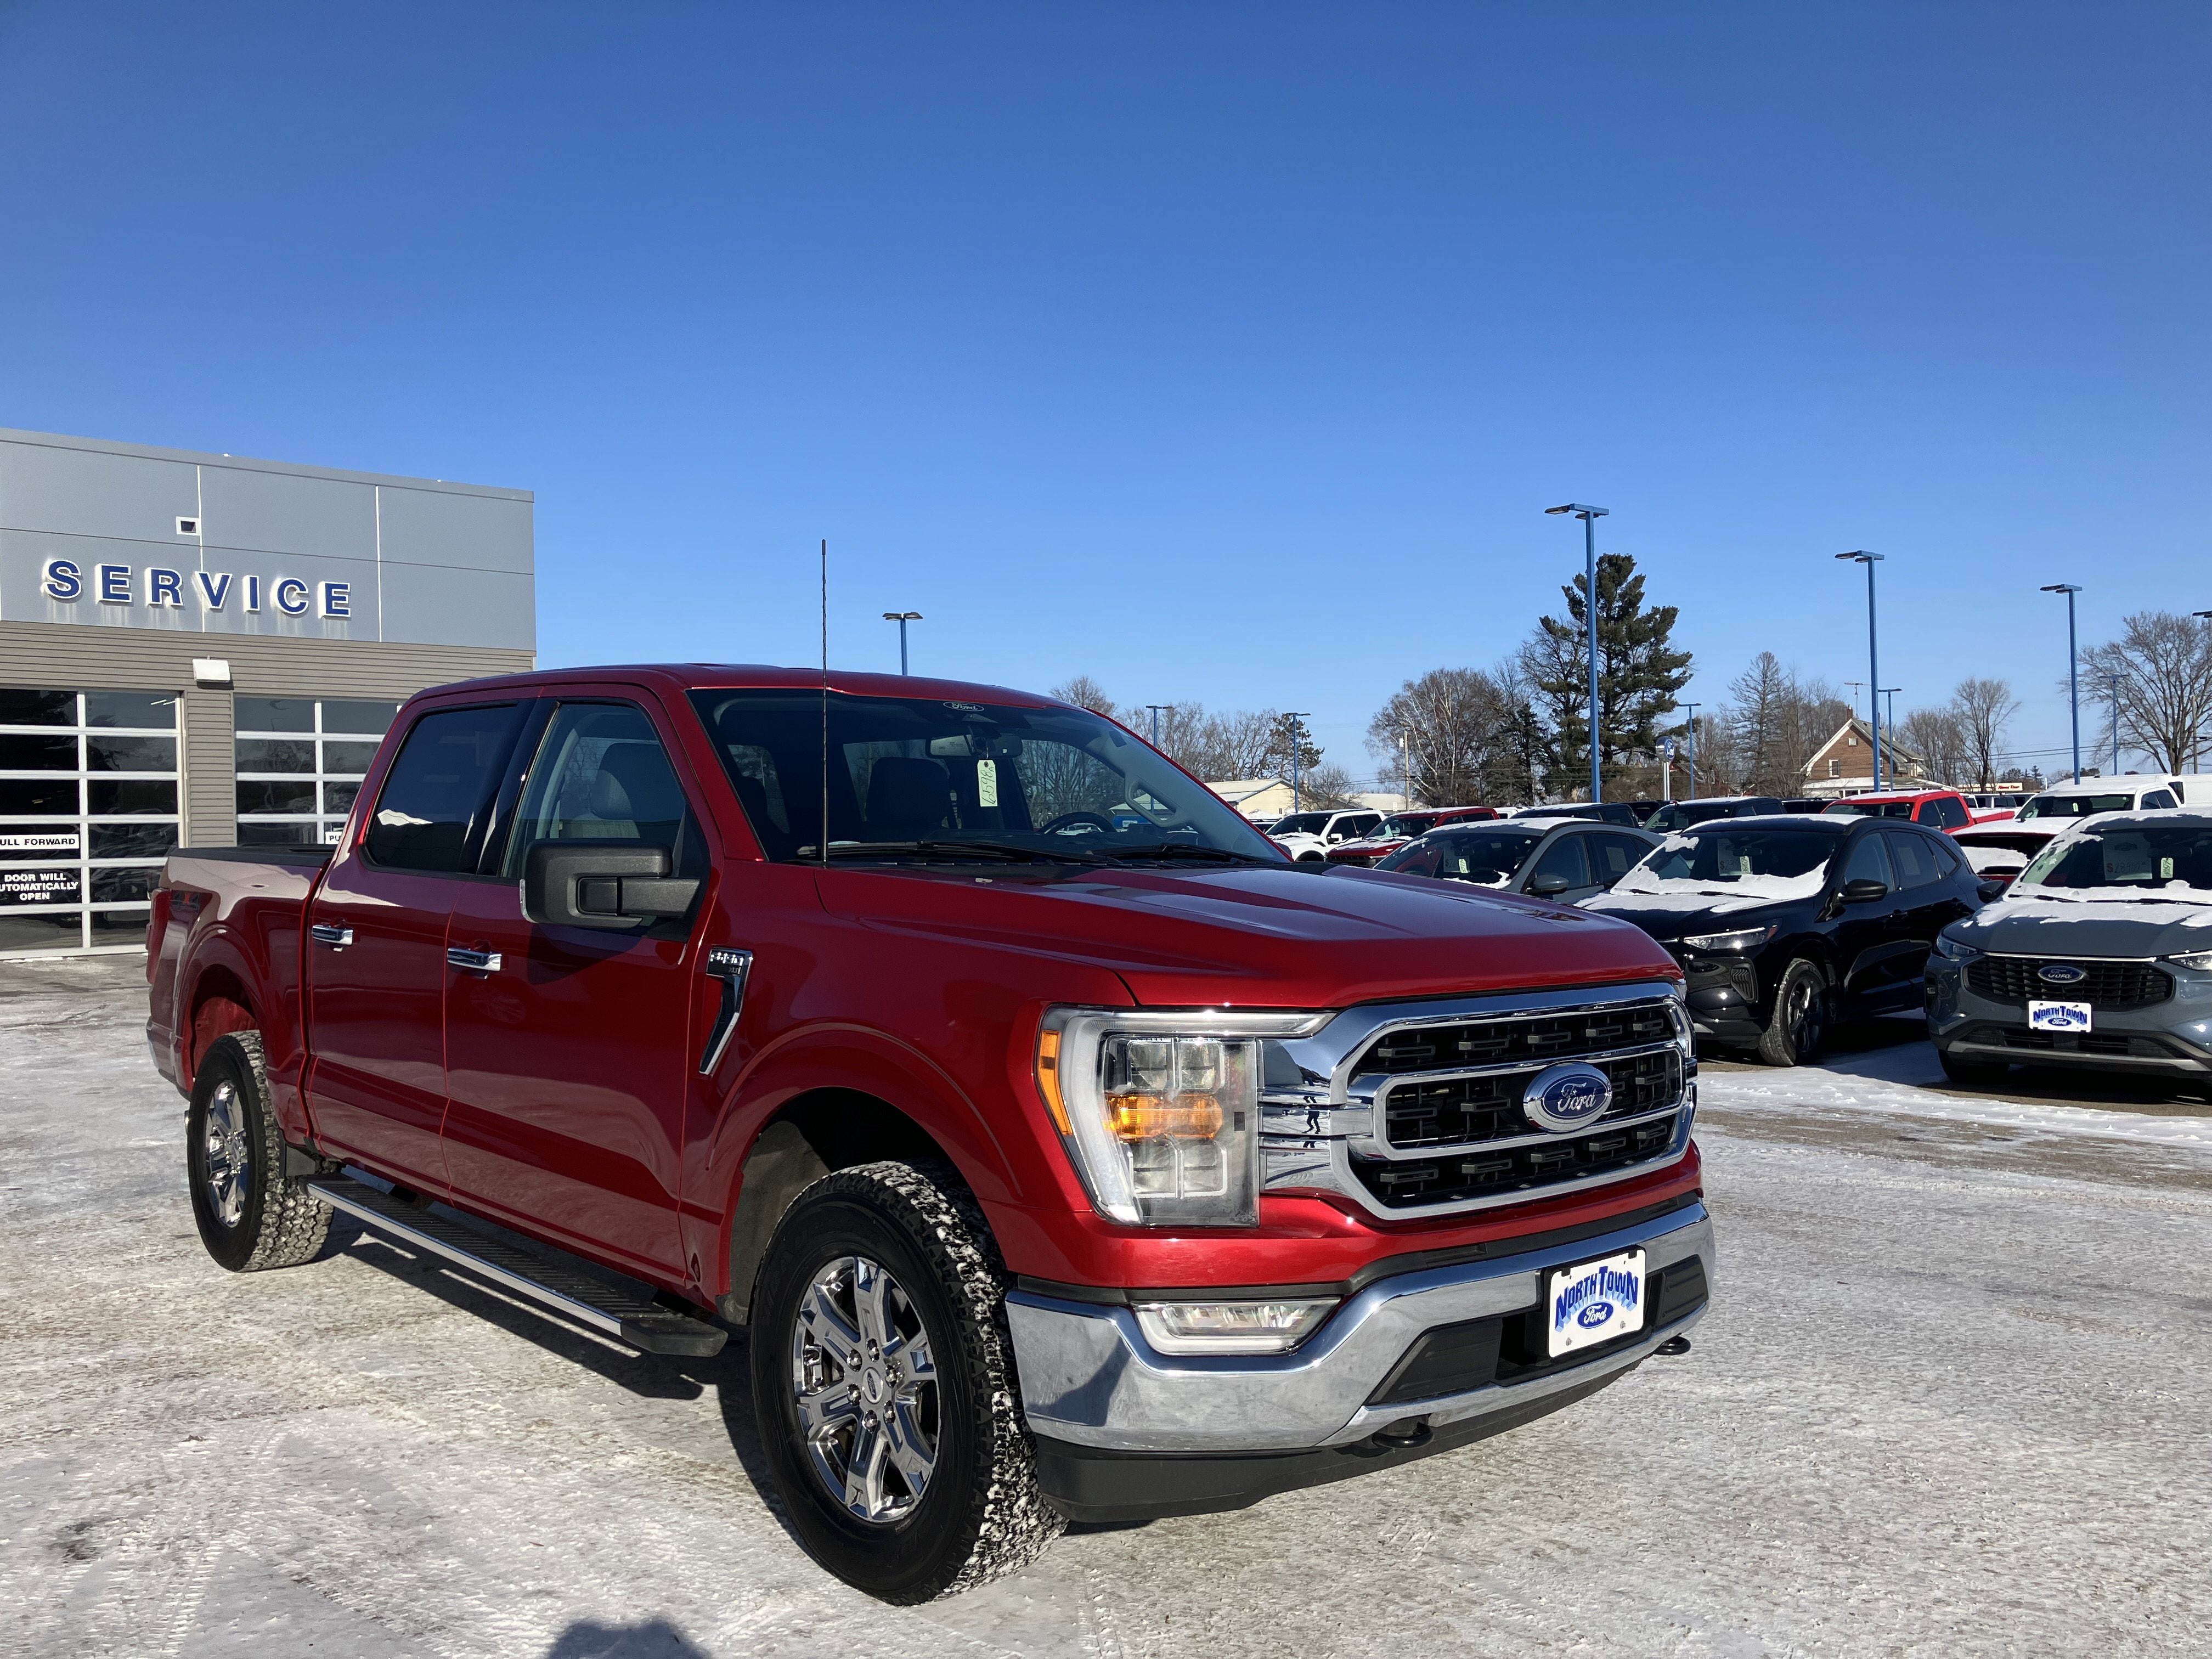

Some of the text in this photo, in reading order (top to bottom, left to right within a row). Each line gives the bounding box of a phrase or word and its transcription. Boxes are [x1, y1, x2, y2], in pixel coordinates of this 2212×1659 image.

[43, 558, 352, 618] SERVICE
[951, 702, 979, 710] Ford
[4, 873, 66, 882] DOOR WILL
[0, 882, 79, 892] UTOMATICALLY
[19, 892, 50, 901] OPEN
[1558, 1082, 1597, 1112] Ford
[1583, 1304, 1607, 1325] Ford
